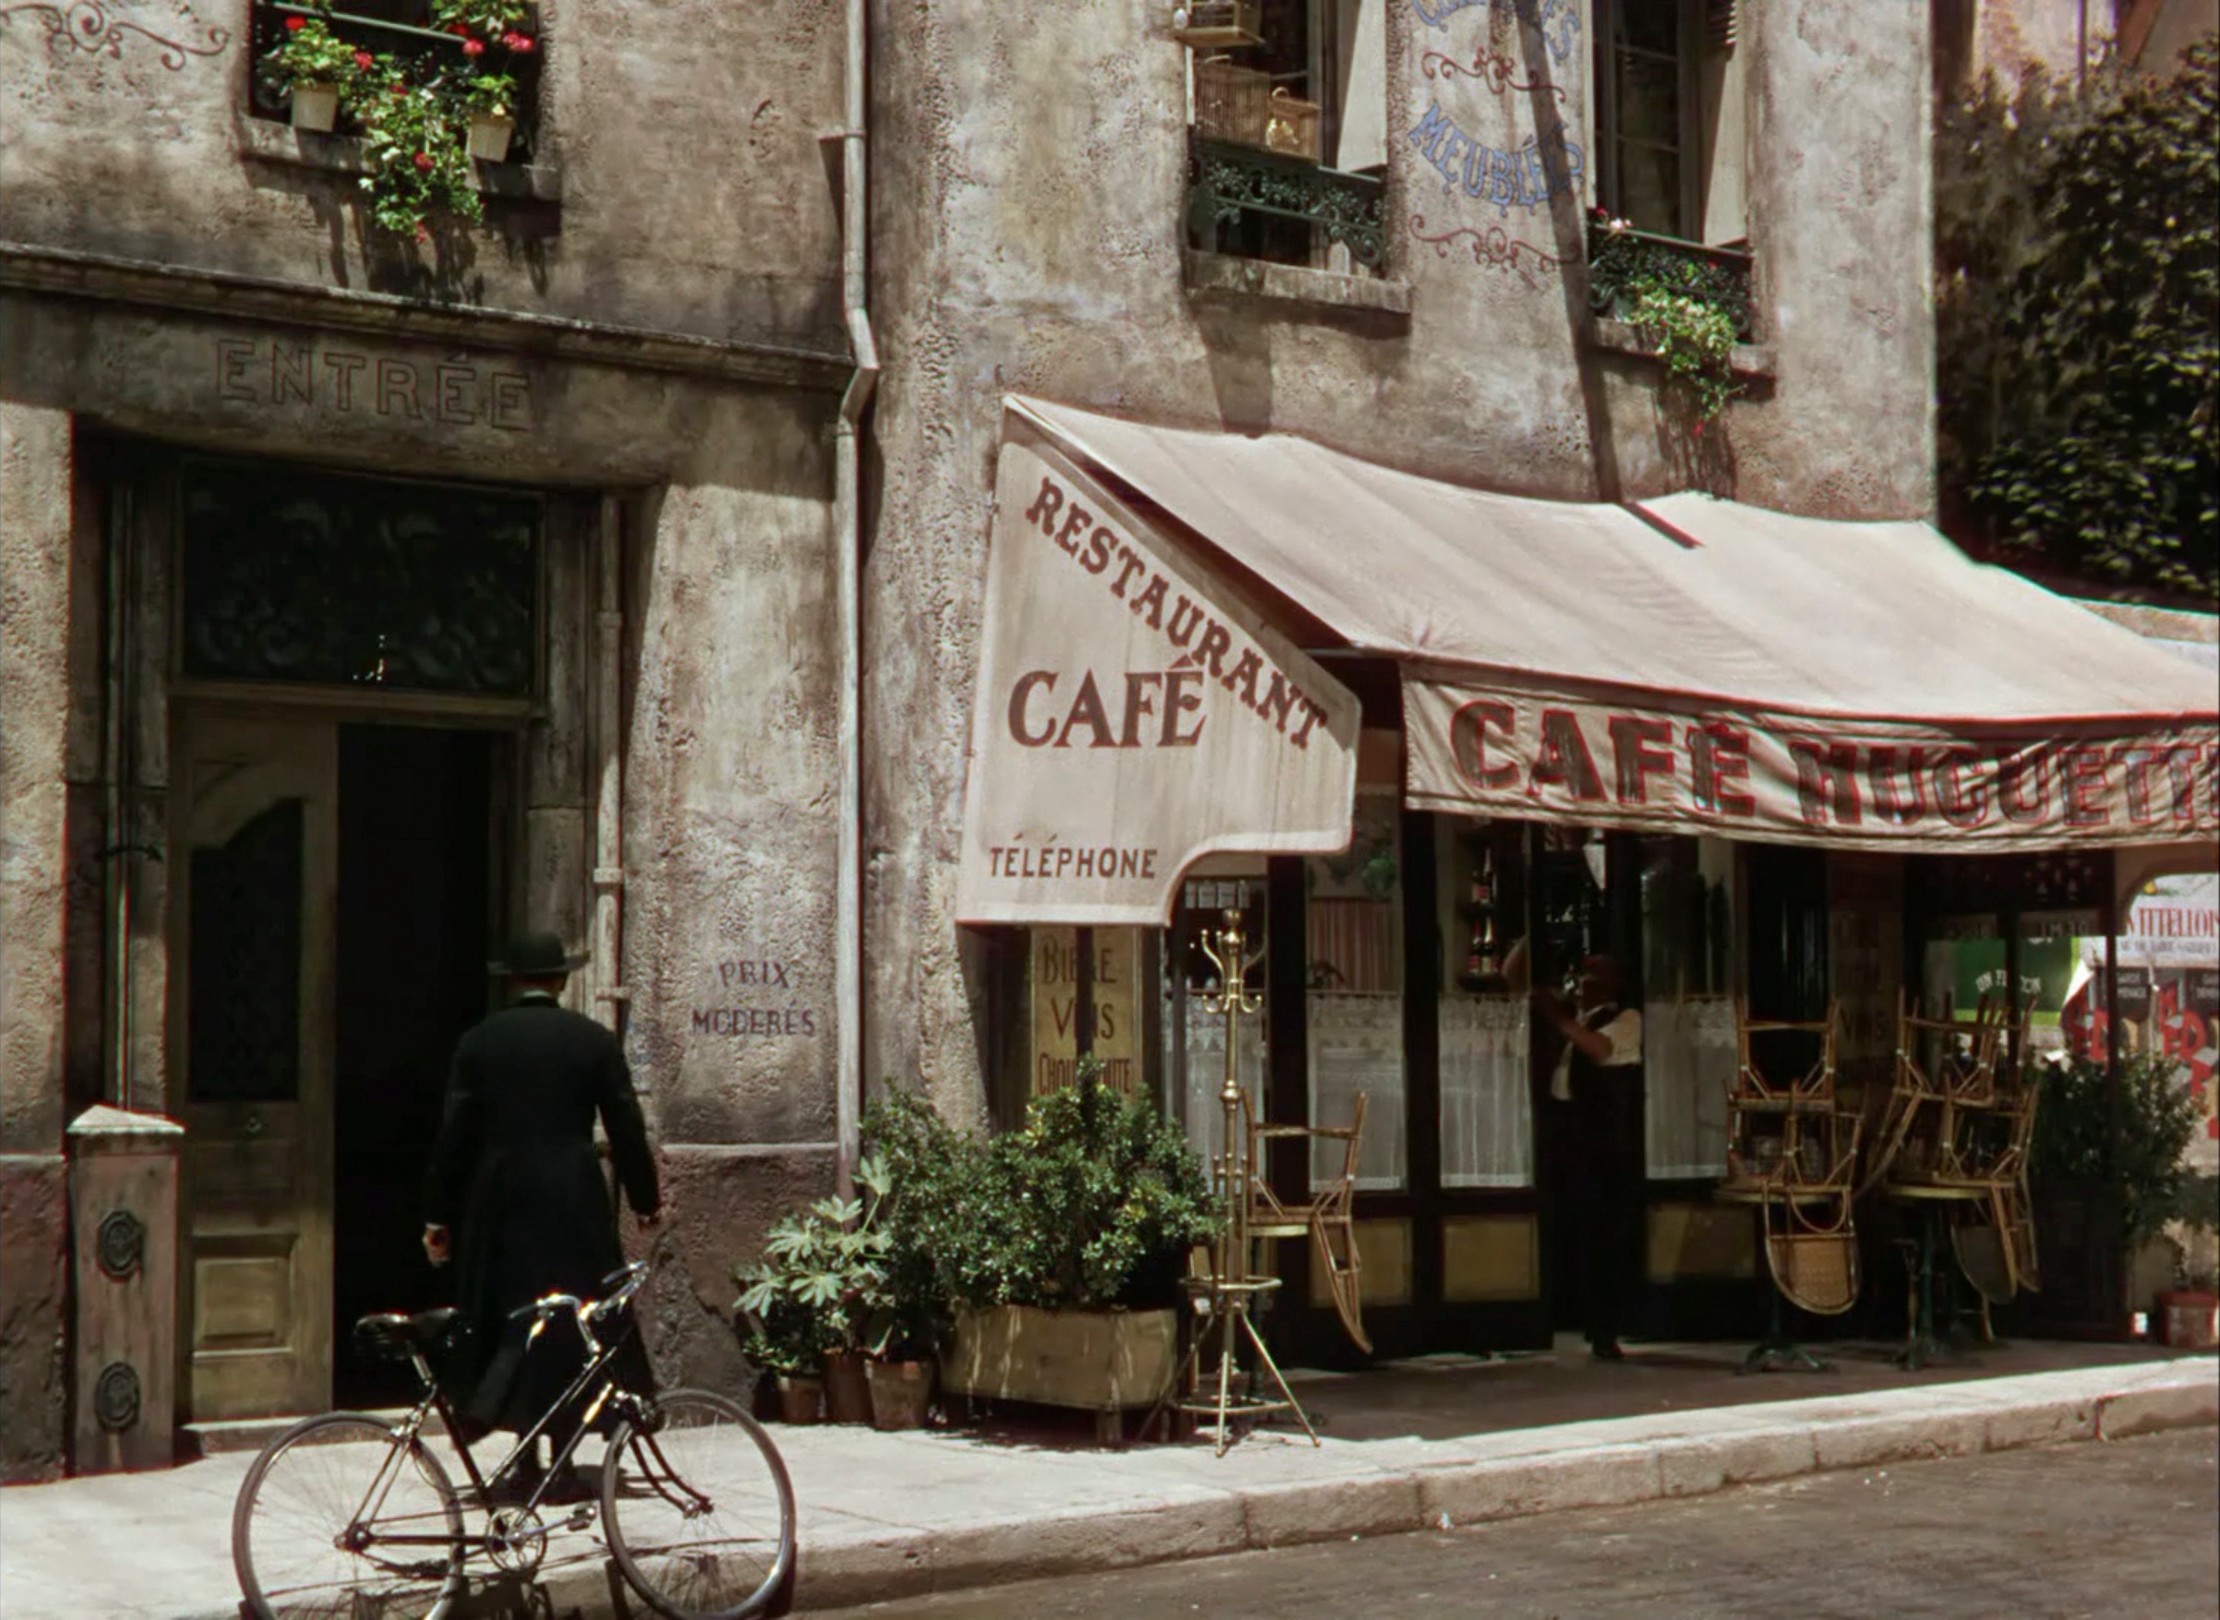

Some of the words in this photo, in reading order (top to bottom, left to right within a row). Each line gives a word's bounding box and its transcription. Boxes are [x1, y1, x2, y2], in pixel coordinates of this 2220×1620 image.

[216, 339, 532, 432] ENTRÉE
[1025, 476, 1329, 749] RESTAURANT
[1007, 654, 1207, 748] CAFÉ
[1450, 699, 1756, 818] CAFÉ
[1789, 740, 2218, 829] HUGUETT
[989, 832, 1158, 879] TÉLÉPHONE
[719, 959, 789, 988] PRIX
[1042, 935, 1117, 985] BIE
[1051, 997, 1114, 1039] VIS
